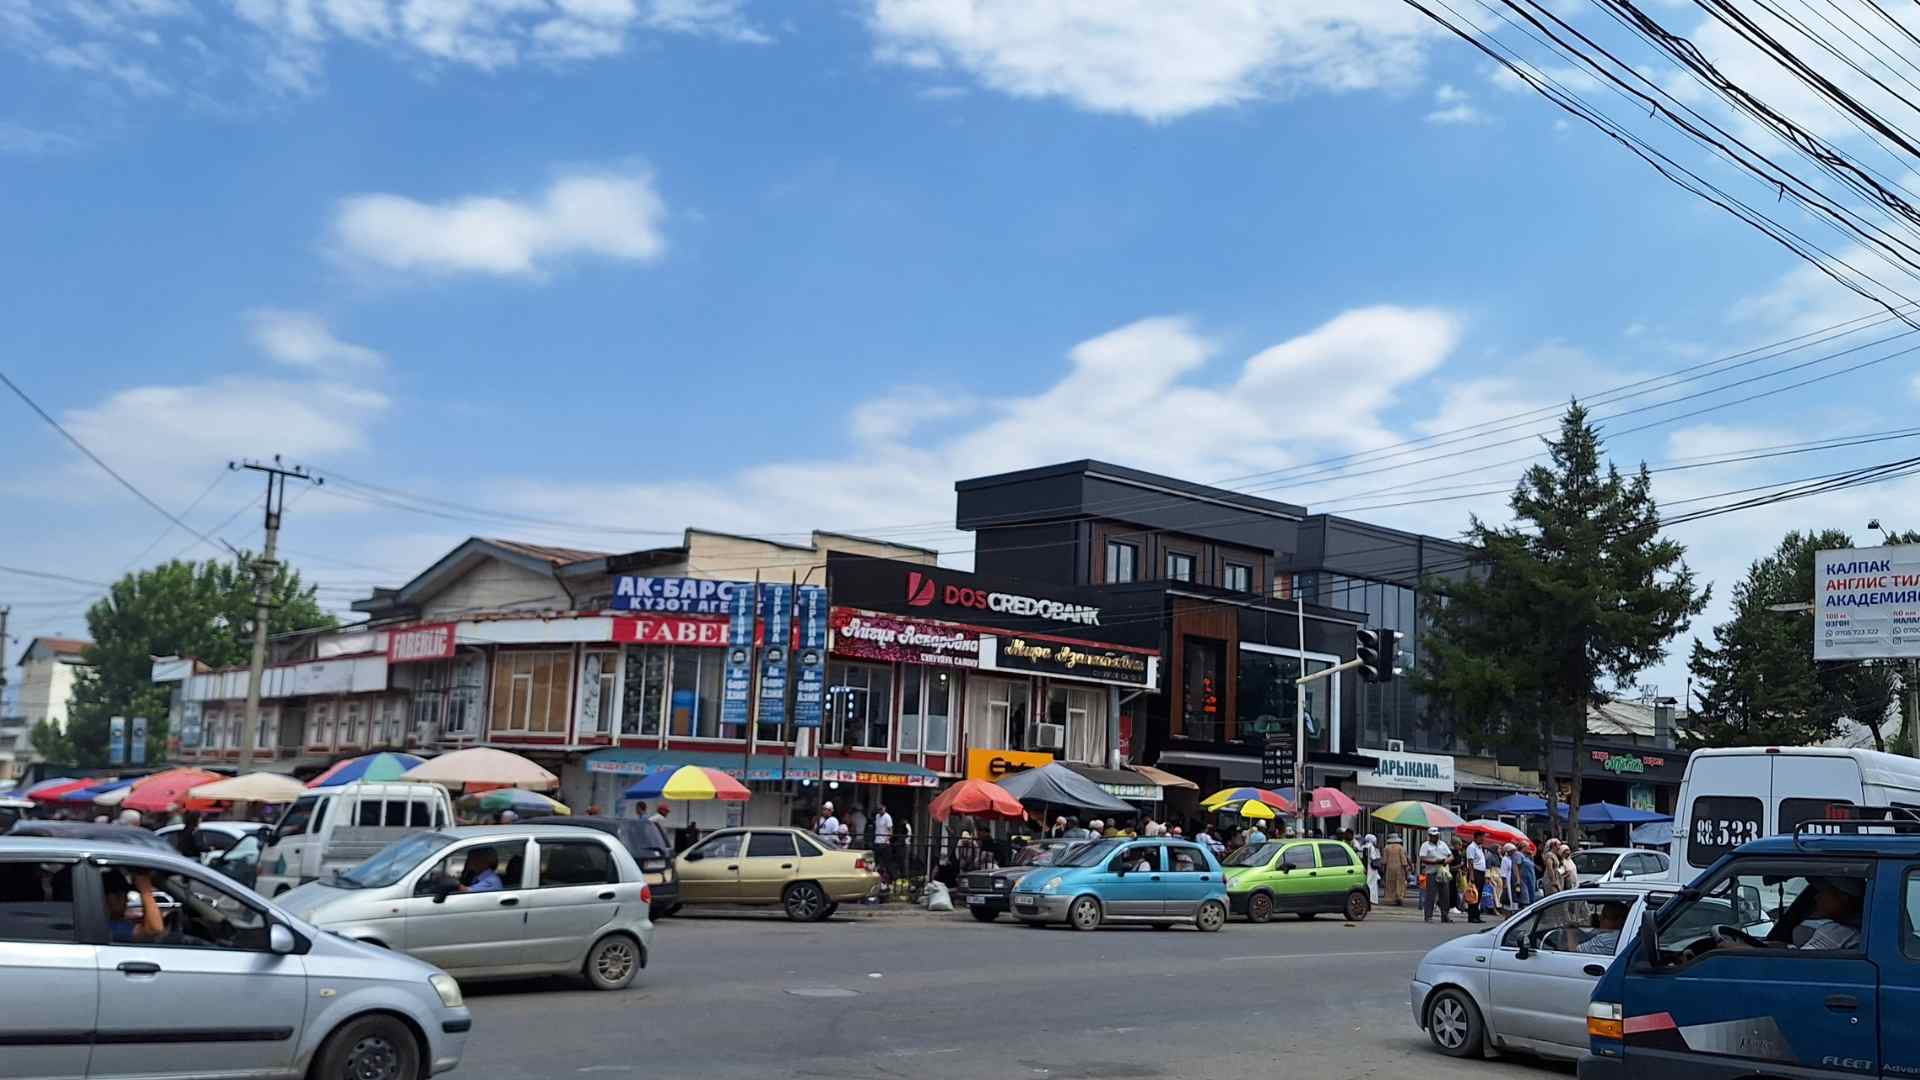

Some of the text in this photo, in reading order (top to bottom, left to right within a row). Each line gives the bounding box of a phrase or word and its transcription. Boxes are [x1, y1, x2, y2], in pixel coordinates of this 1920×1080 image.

[1826, 560, 1890, 575] КАЛПАК
[617, 576, 733, 600] АК-БАРС
[1826, 576, 1888, 591] АНГЛИС
[1697, 819, 1713, 832] 06
[1717, 820, 1758, 846] 533
[1697, 832, 1713, 845] KG
[1822, 1056, 1873, 1070] FLEET
